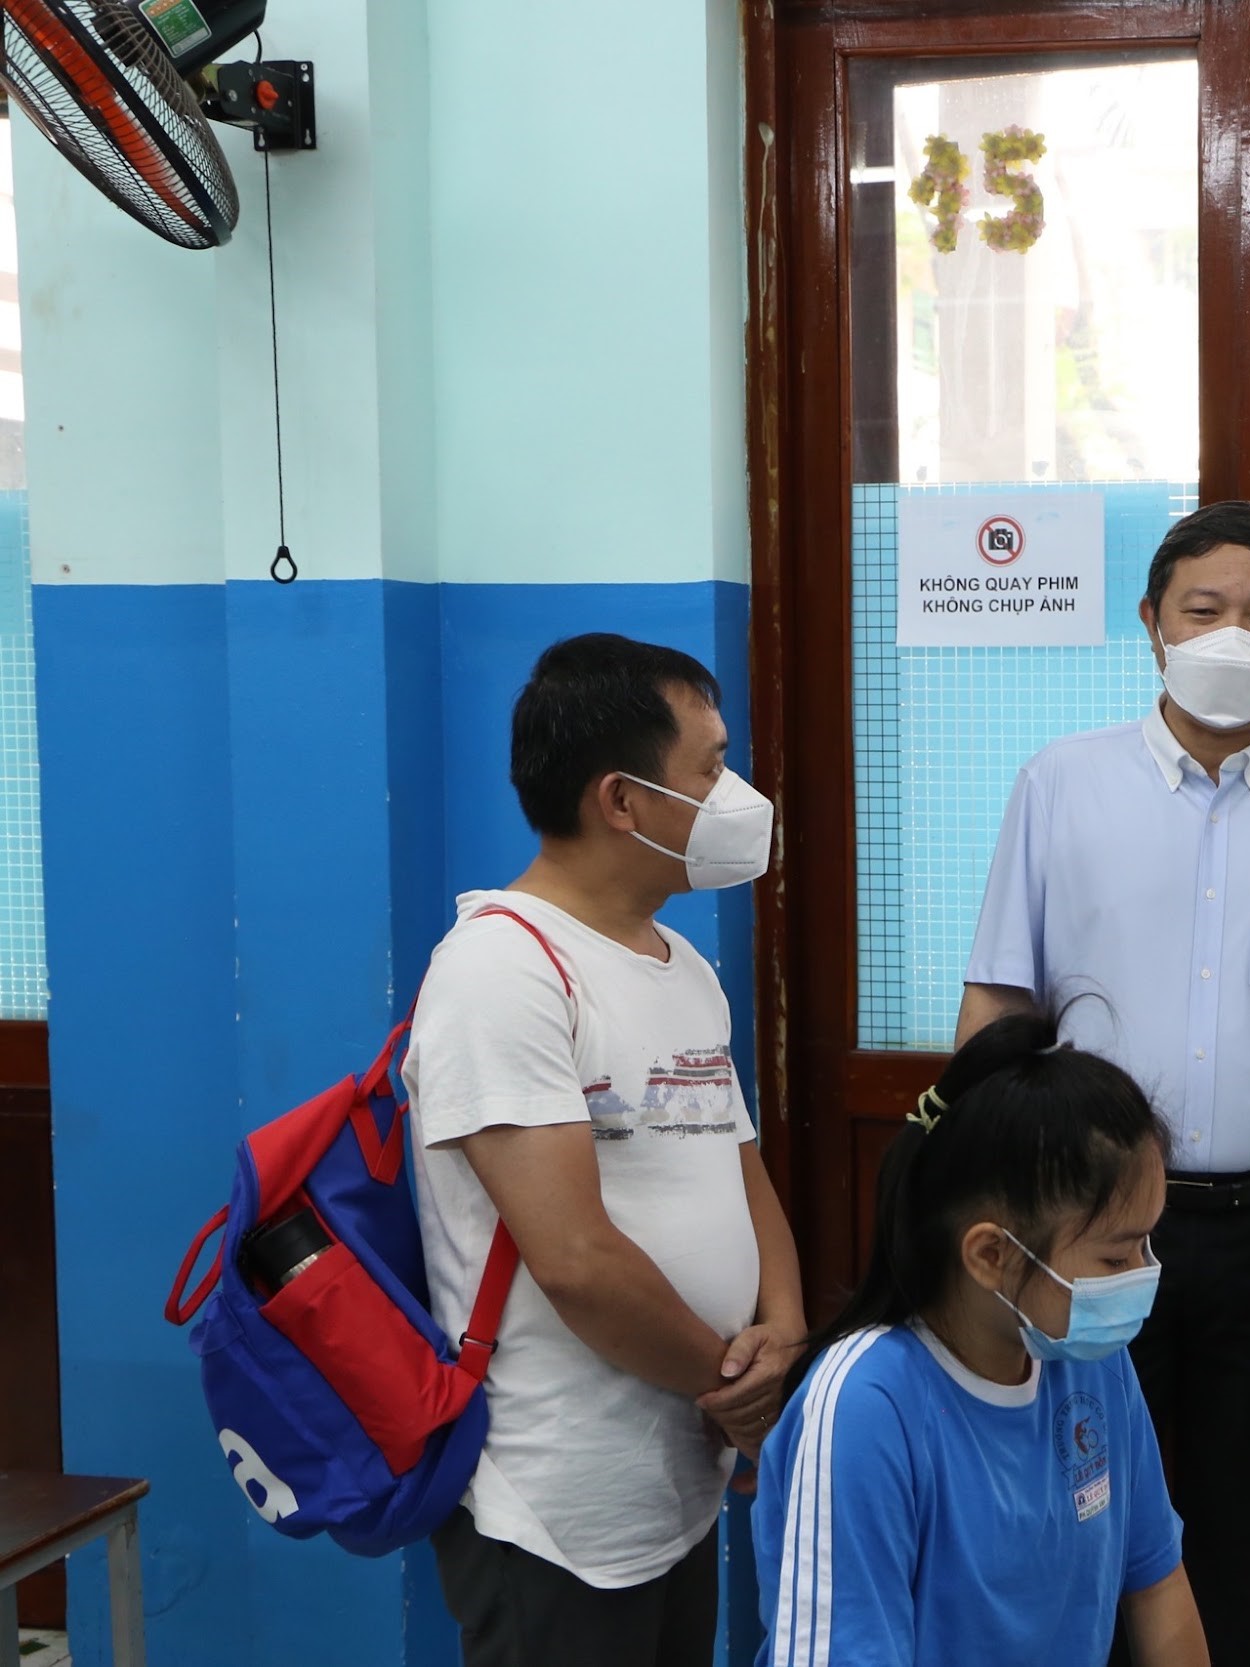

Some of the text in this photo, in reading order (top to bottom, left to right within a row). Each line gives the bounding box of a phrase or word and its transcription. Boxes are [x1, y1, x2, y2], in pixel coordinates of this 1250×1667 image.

[908, 124, 1047, 255] 15
[920, 575, 1079, 591] KHÔNG QUAY PHIM
[922, 596, 1075, 615] KHÔNG CHỤP ẢNH
